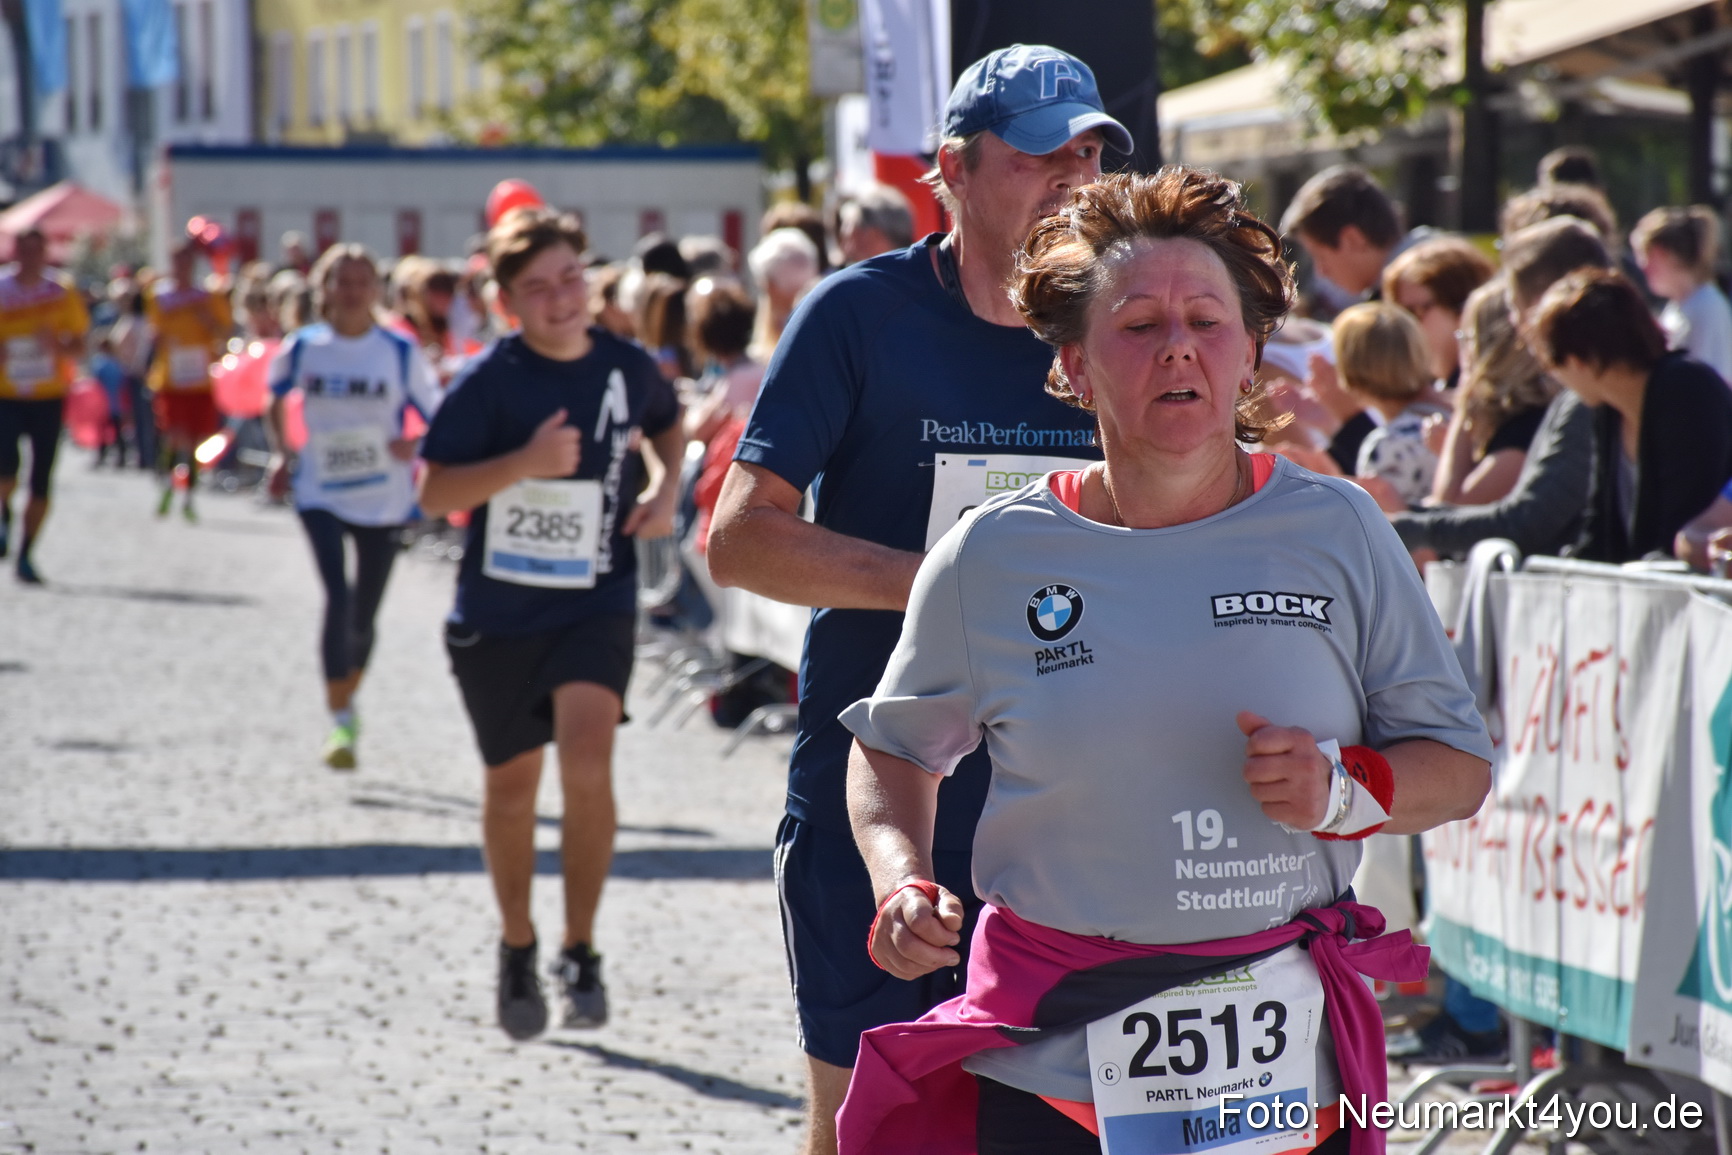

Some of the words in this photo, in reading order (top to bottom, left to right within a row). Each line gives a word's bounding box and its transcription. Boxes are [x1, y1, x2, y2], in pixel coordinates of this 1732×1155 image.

[507, 506, 583, 542] 2385
[1029, 585, 1078, 609] BMW
[1210, 591, 1334, 625] BOCK
[1213, 617, 1254, 628] inspired
[1256, 616, 1268, 626] by
[1270, 618, 1296, 627] smart
[1034, 640, 1092, 666] PARTL
[1036, 654, 1094, 677] Neumarkt
[1171, 809, 1238, 851] 19.
[1175, 853, 1307, 880] Neumarkter
[1176, 882, 1287, 911] Stadtlauf
[1186, 988, 1195, 997] by
[1197, 985, 1220, 995] smart
[1223, 983, 1257, 993] concepts
[1122, 1001, 1288, 1079] 2513
[1105, 1068, 1114, 1080] C
[1146, 1088, 1193, 1102] PARTL
[1197, 1077, 1254, 1099] Neumarkt
